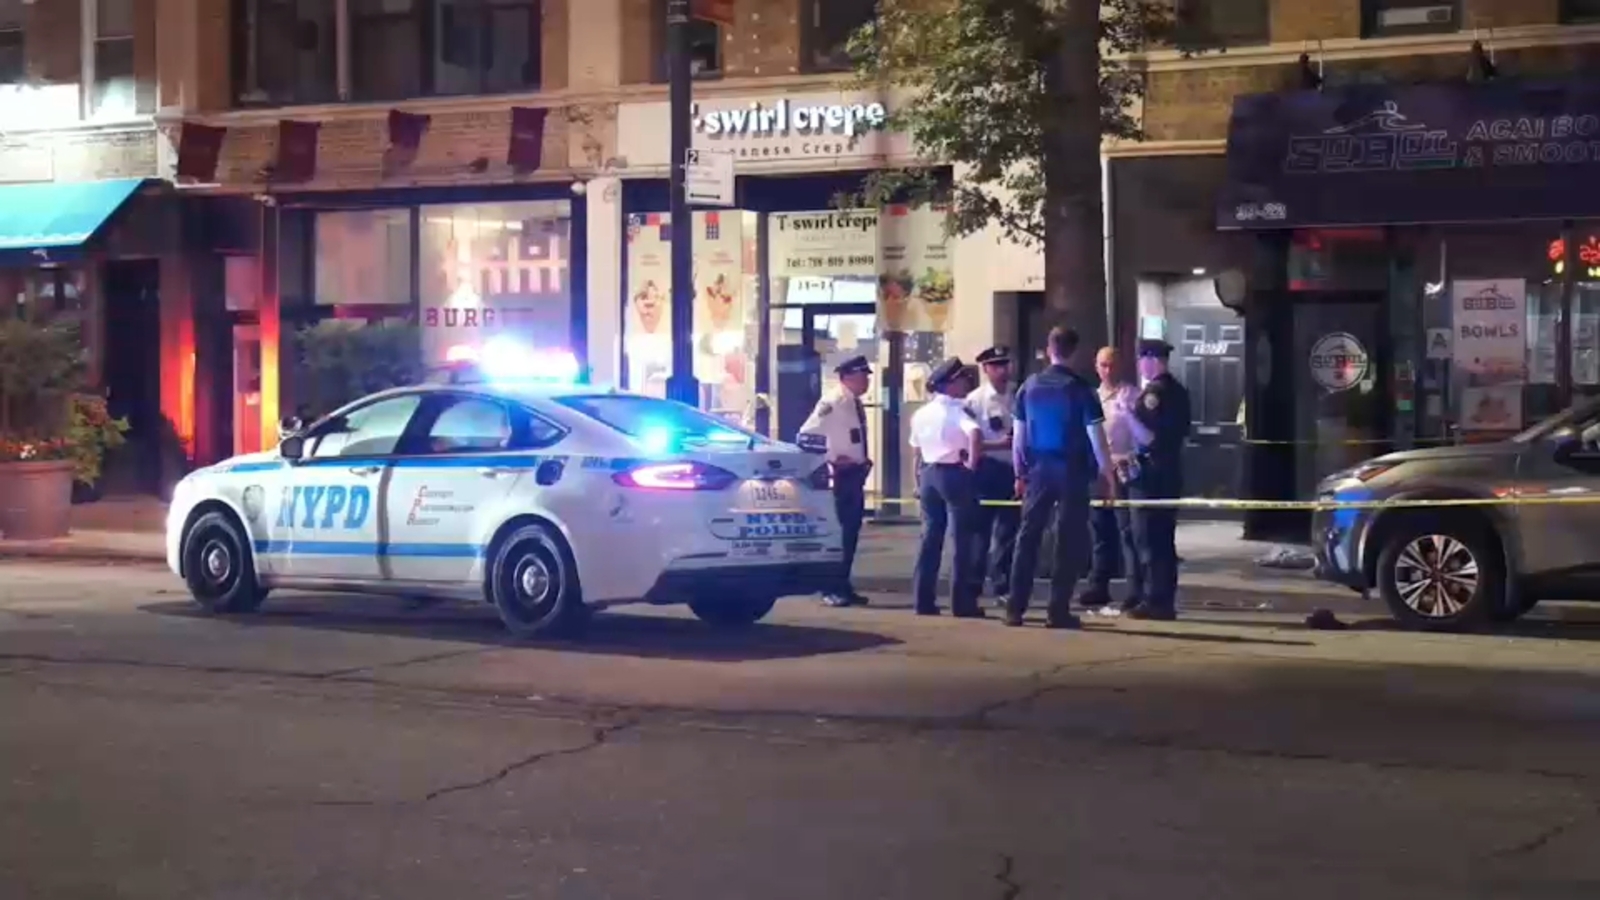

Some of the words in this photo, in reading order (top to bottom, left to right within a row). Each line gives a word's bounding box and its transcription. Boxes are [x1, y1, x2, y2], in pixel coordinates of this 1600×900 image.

[793, 102, 886, 136] crepe
[1466, 118, 1544, 140] ACAI
[1464, 146, 1482, 167] &
[1461, 323, 1519, 339] BOWLS
[276, 484, 370, 529] NYPD
[746, 513, 807, 524] NYPD
[740, 525, 818, 537] POLICE
